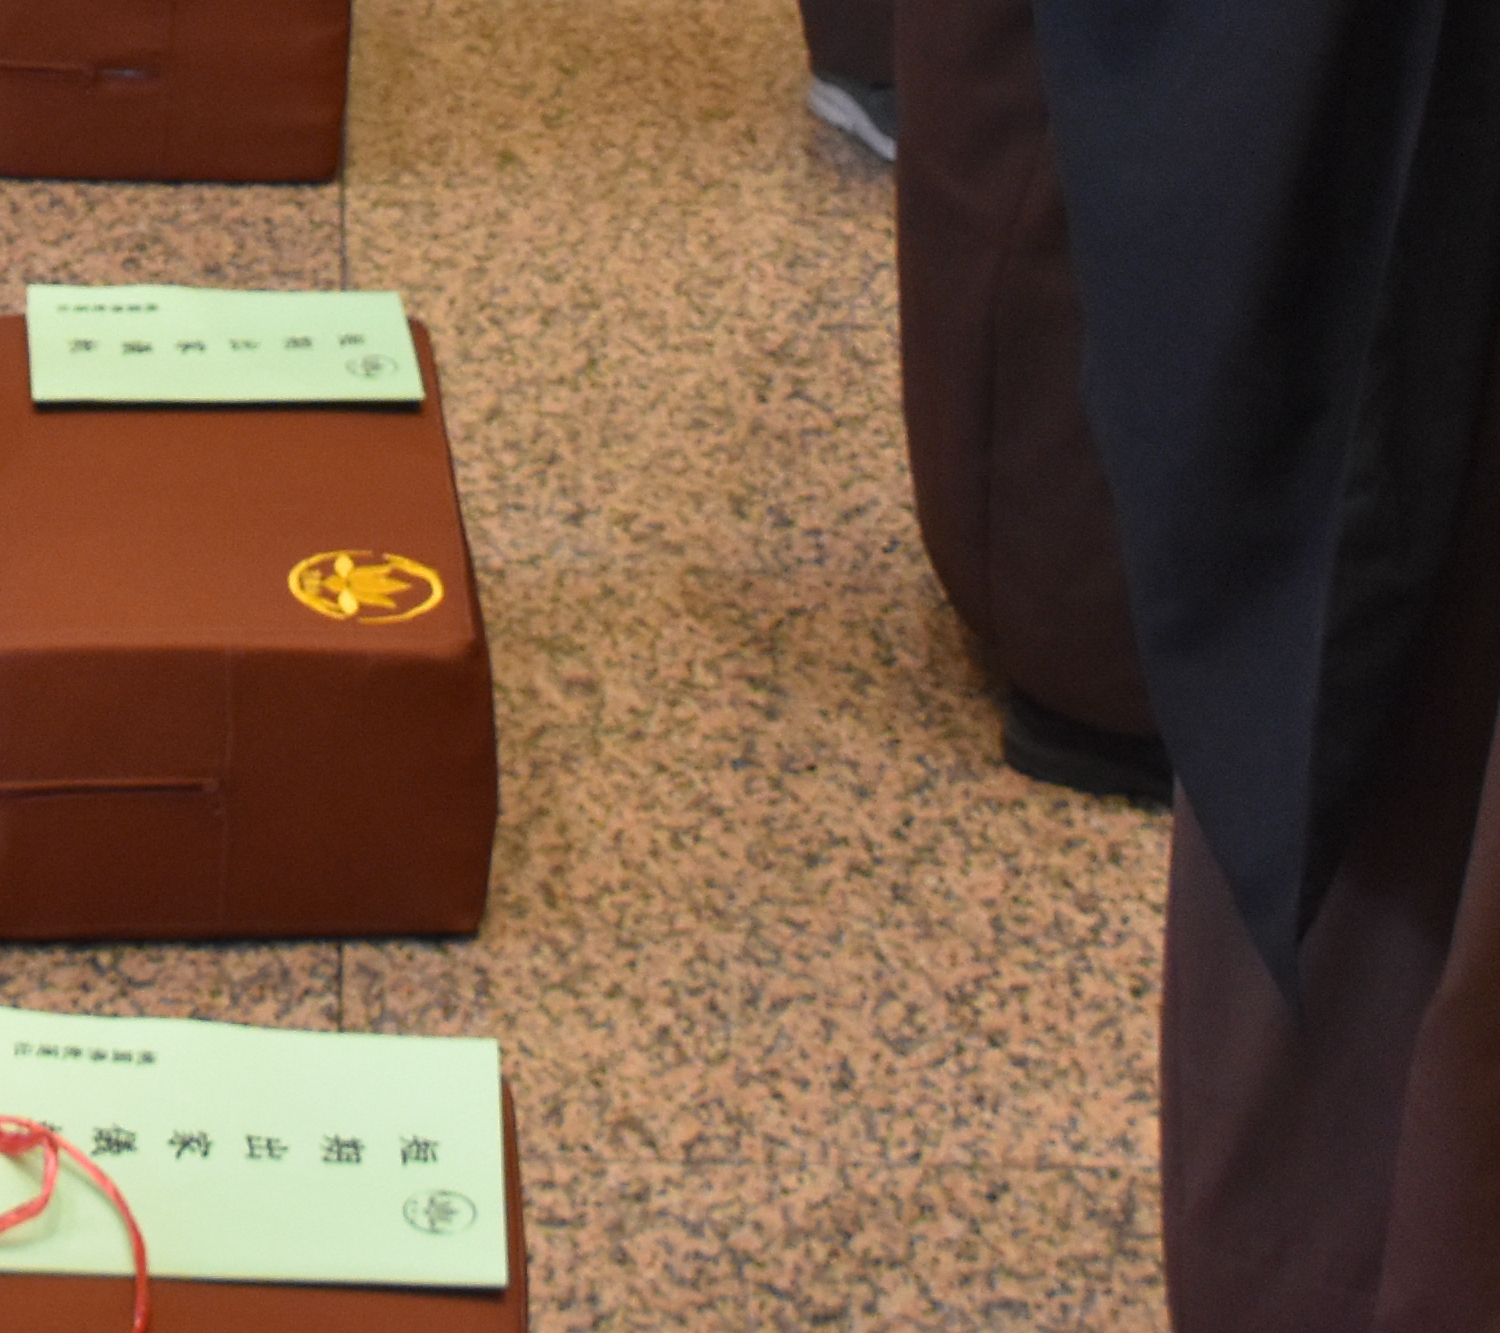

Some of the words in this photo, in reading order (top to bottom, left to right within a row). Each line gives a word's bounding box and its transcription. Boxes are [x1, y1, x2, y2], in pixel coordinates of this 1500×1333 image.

[40, 1121, 439, 1165] 短期出家儀
